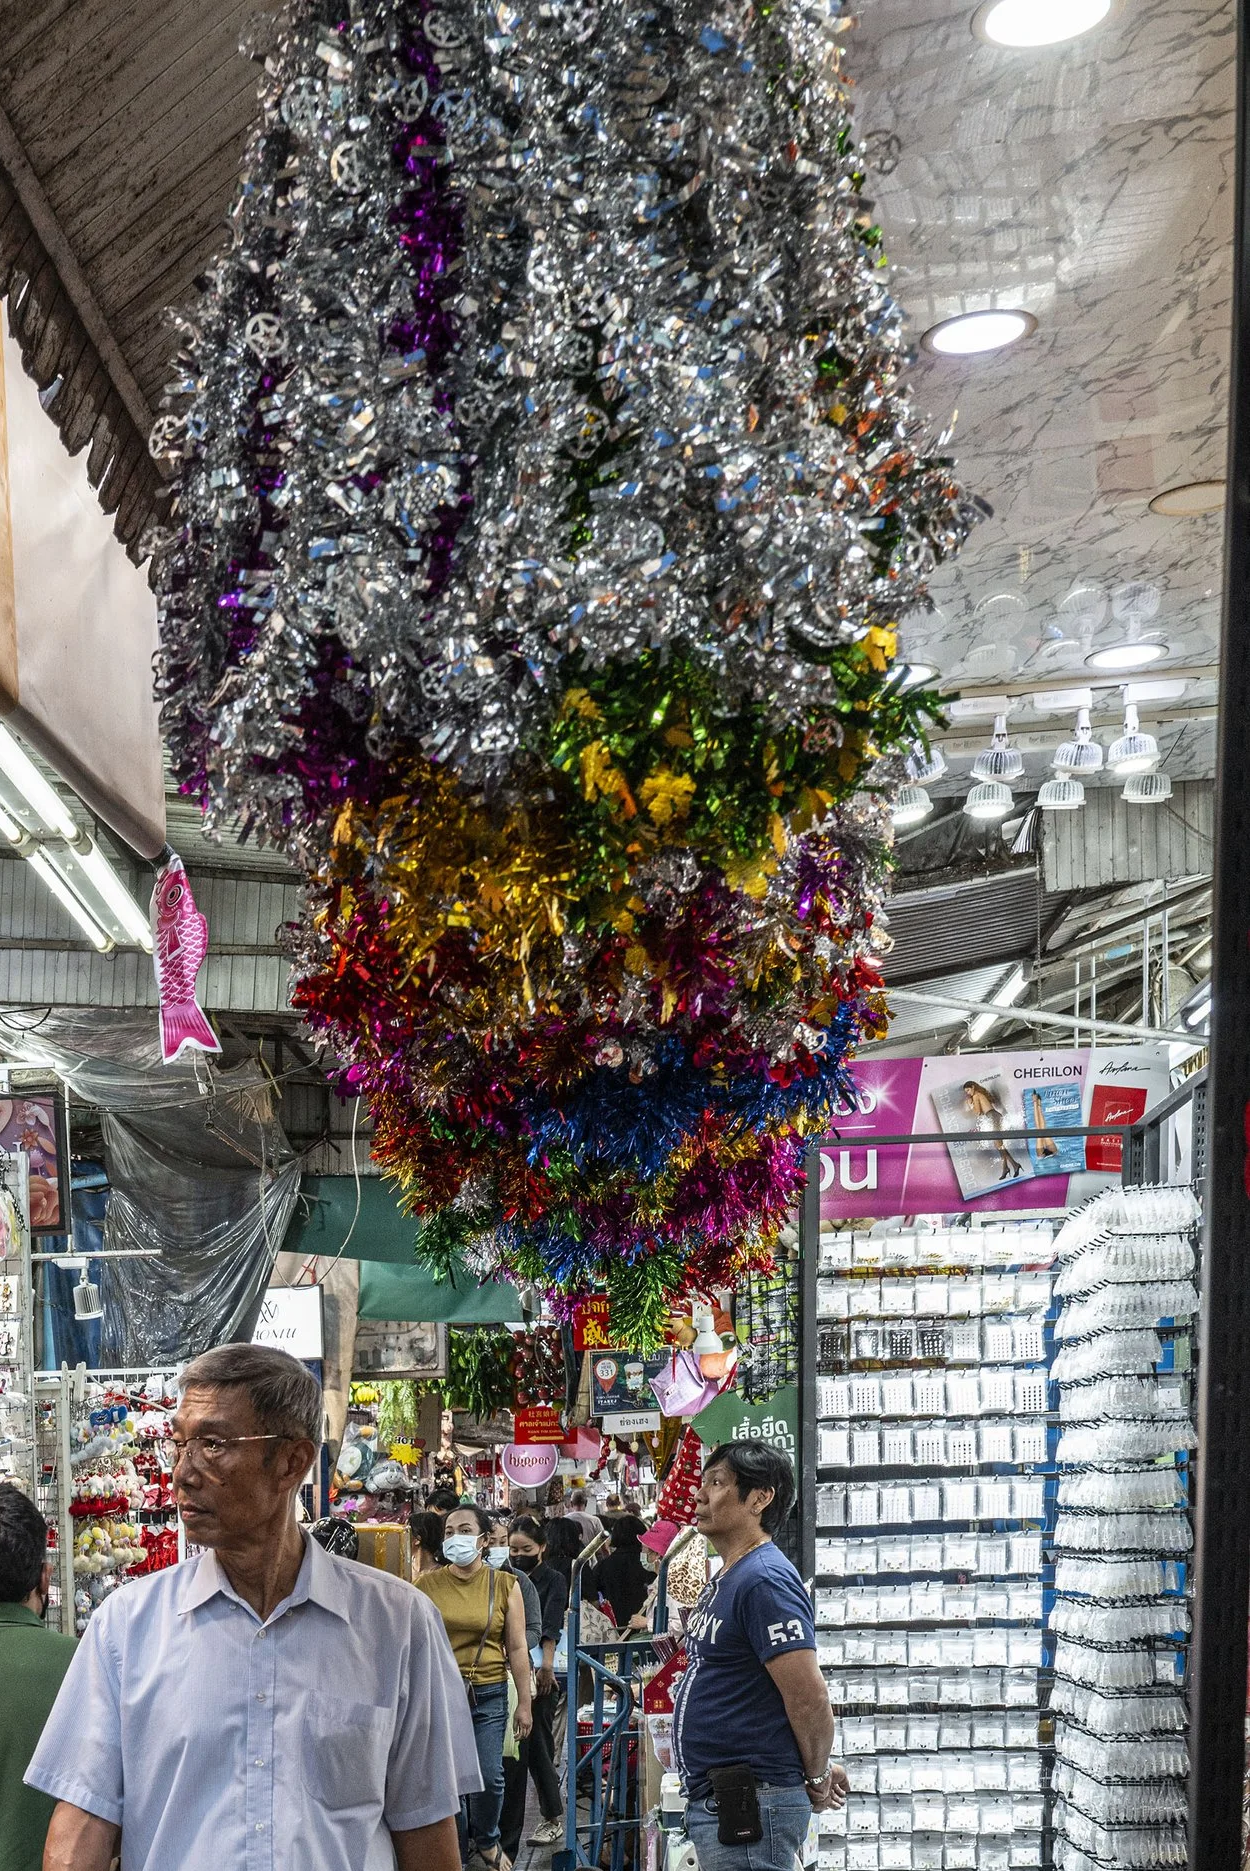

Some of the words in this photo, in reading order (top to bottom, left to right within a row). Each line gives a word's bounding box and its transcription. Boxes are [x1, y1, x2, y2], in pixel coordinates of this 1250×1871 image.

[1013, 1064, 1083, 1081] CHERILON
[599, 1369, 614, 1377] 331
[732, 1415, 789, 1440] เสื้อยืด
[394, 1436, 415, 1445] HOT
[767, 1618, 805, 1647] 53
